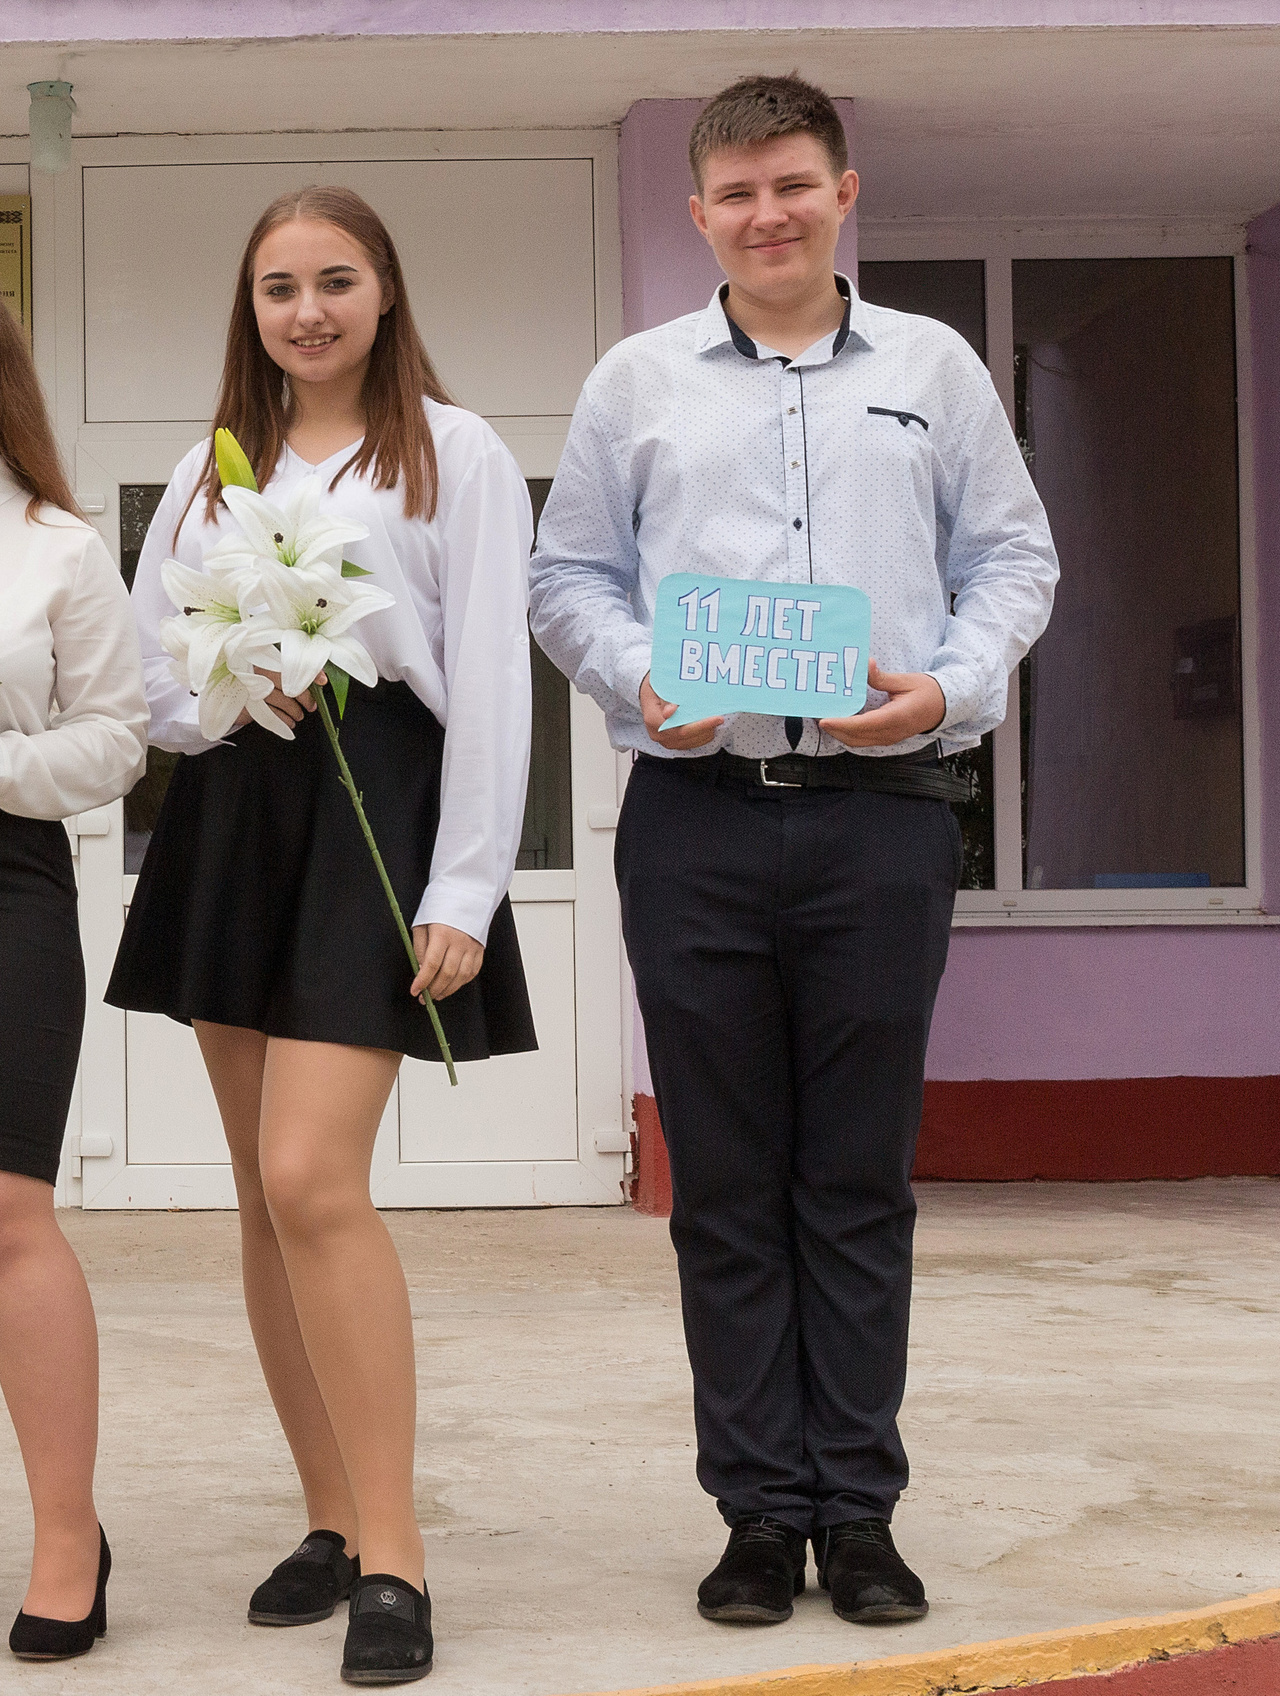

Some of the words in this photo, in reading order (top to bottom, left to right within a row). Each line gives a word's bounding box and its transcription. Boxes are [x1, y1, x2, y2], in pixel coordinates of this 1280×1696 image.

[678, 586, 721, 633] 11
[740, 594, 822, 642] ЛЕТ
[678, 638, 860, 697] ВМЕСТЕ!
